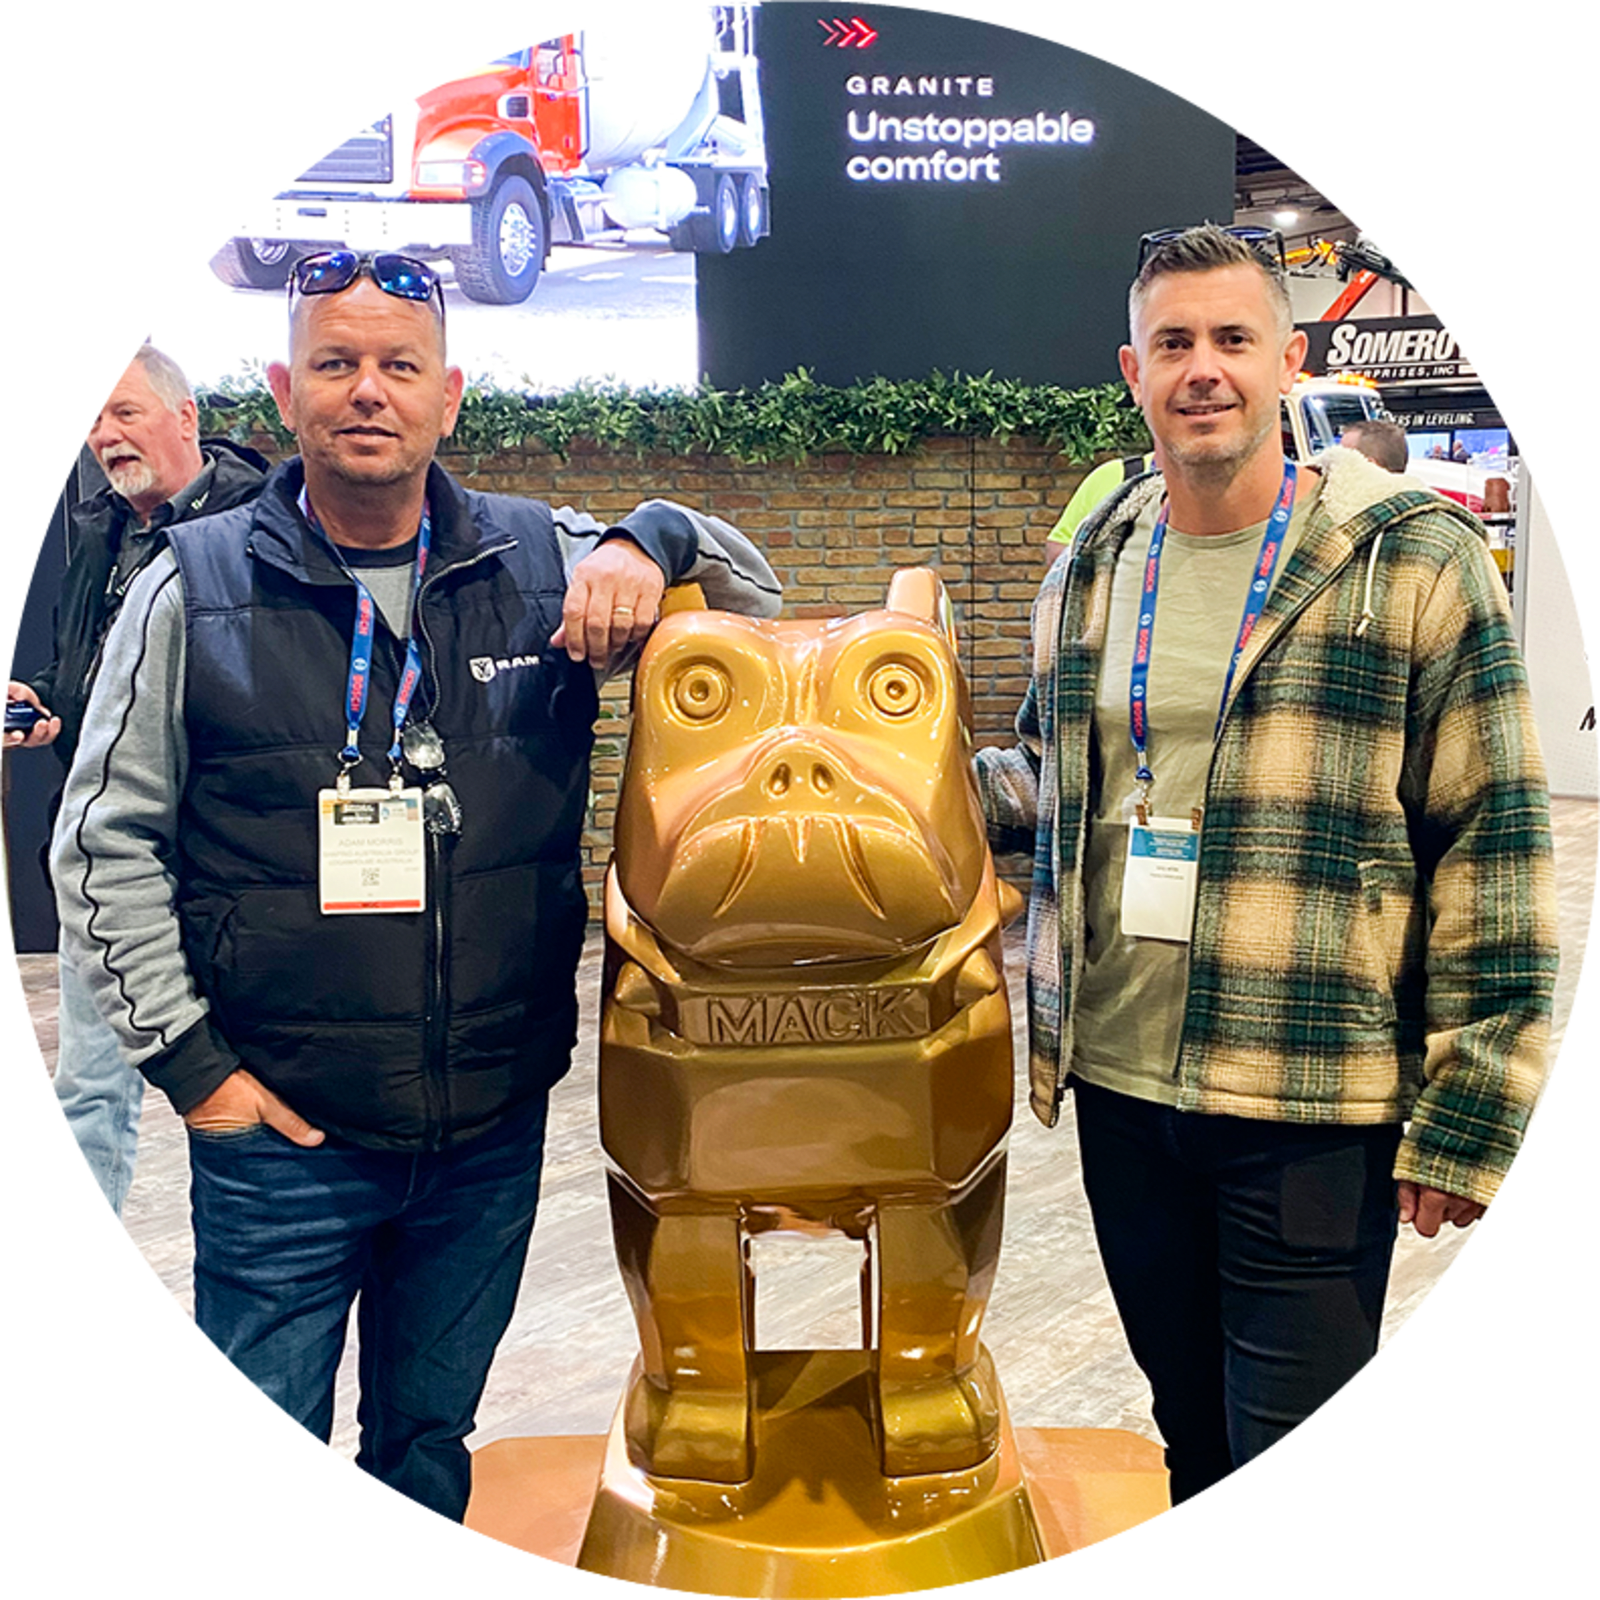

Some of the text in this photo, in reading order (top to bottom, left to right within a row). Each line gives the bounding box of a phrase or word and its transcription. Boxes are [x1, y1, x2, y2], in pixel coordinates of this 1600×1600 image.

[846, 76, 994, 96] GRANITE
[846, 110, 1095, 147] Unstoppable
[846, 150, 1000, 181] comfort
[1145, 558, 1157, 593] BOSCH
[1259, 542, 1277, 577] BOSCH
[496, 655, 540, 670] RAM
[1136, 629, 1149, 663] BOSCH
[351, 674, 364, 711] BOSCH
[398, 669, 415, 705] BOSCH
[1132, 701, 1143, 737] BOSCH
[338, 837, 404, 847] ADAM MORRIS
[707, 990, 922, 1043] MACK
